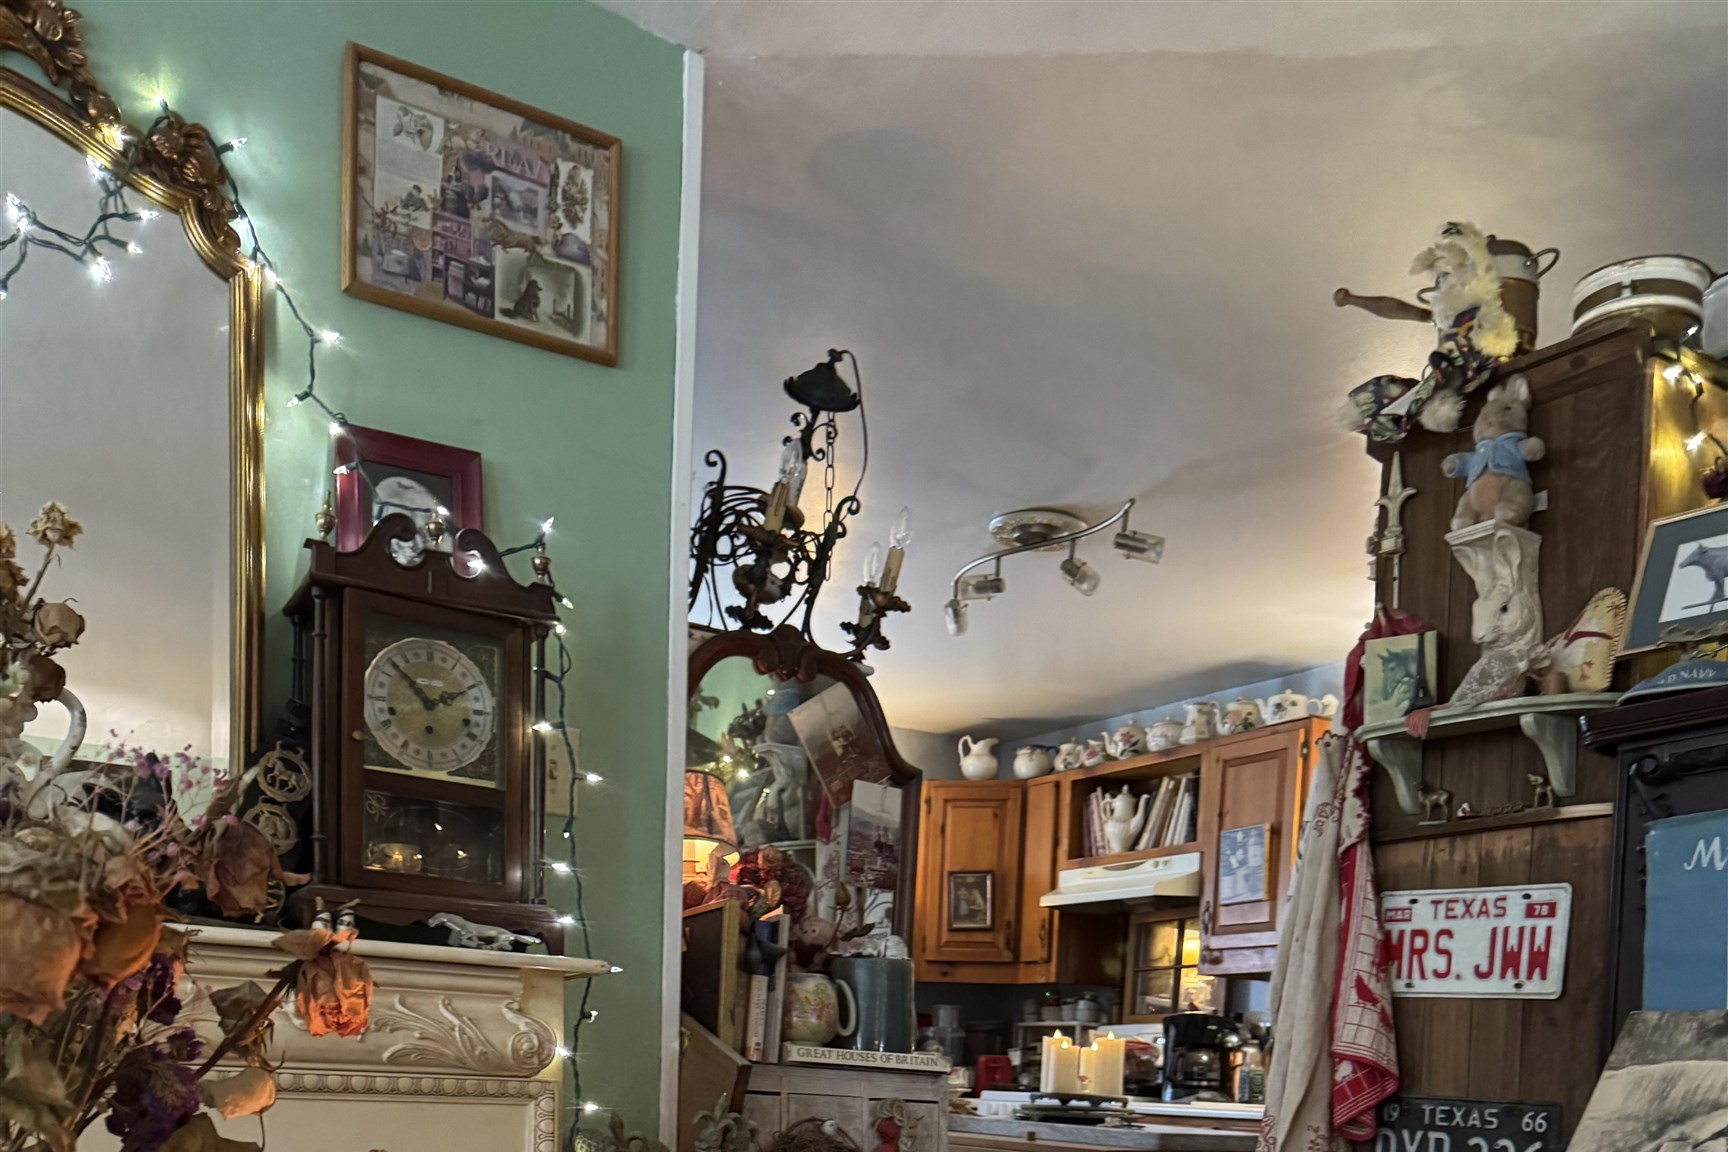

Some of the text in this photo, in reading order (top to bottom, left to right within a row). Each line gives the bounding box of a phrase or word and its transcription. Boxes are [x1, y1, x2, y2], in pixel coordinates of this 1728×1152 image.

[1430, 897, 1508, 920] TEXAS
[1474, 926, 1553, 981] JWW
[797, 1047, 938, 1067] GREAT HOUSES OF BRITAIN
[1421, 1104, 1499, 1129] TEXAS
[1521, 1111, 1548, 1133] 66
